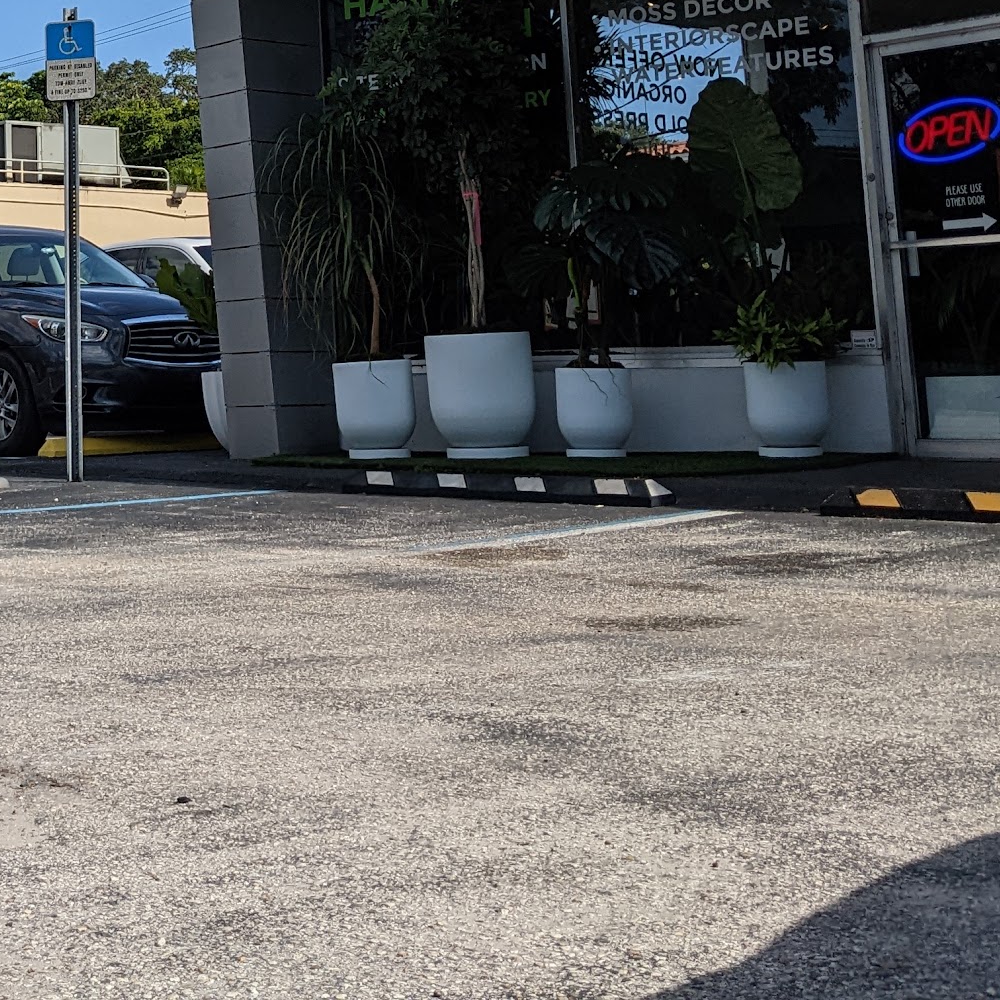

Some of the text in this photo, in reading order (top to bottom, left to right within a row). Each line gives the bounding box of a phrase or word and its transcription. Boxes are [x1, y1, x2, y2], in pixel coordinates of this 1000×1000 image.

[608, 1, 677, 27] MOSS
[610, 15, 811, 54] INTERIORSCAPE
[611, 44, 835, 85] WATER FEATURES
[904, 106, 993, 155] OPEN
[945, 182, 984, 196] PLEASE USE
[945, 194, 986, 208] OTHER DOOR
